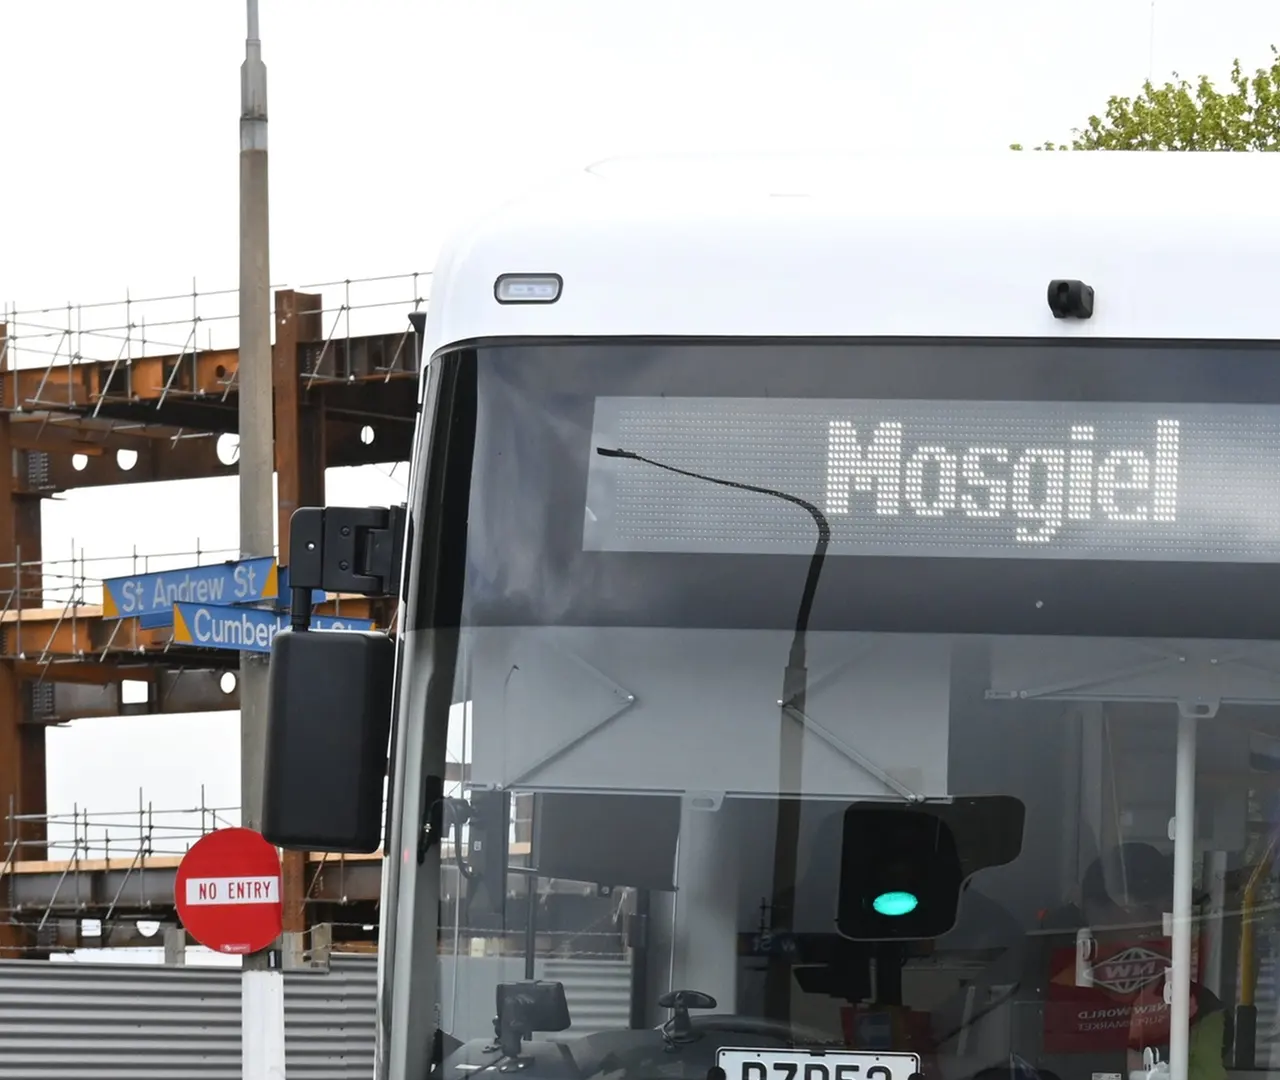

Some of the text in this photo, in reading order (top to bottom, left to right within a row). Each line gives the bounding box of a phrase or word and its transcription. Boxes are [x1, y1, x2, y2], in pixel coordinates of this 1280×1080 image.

[825, 419, 1180, 544] Mosgiel
[121, 565, 257, 613] St Andrew St
[199, 881, 272, 901] NO ENTRY
